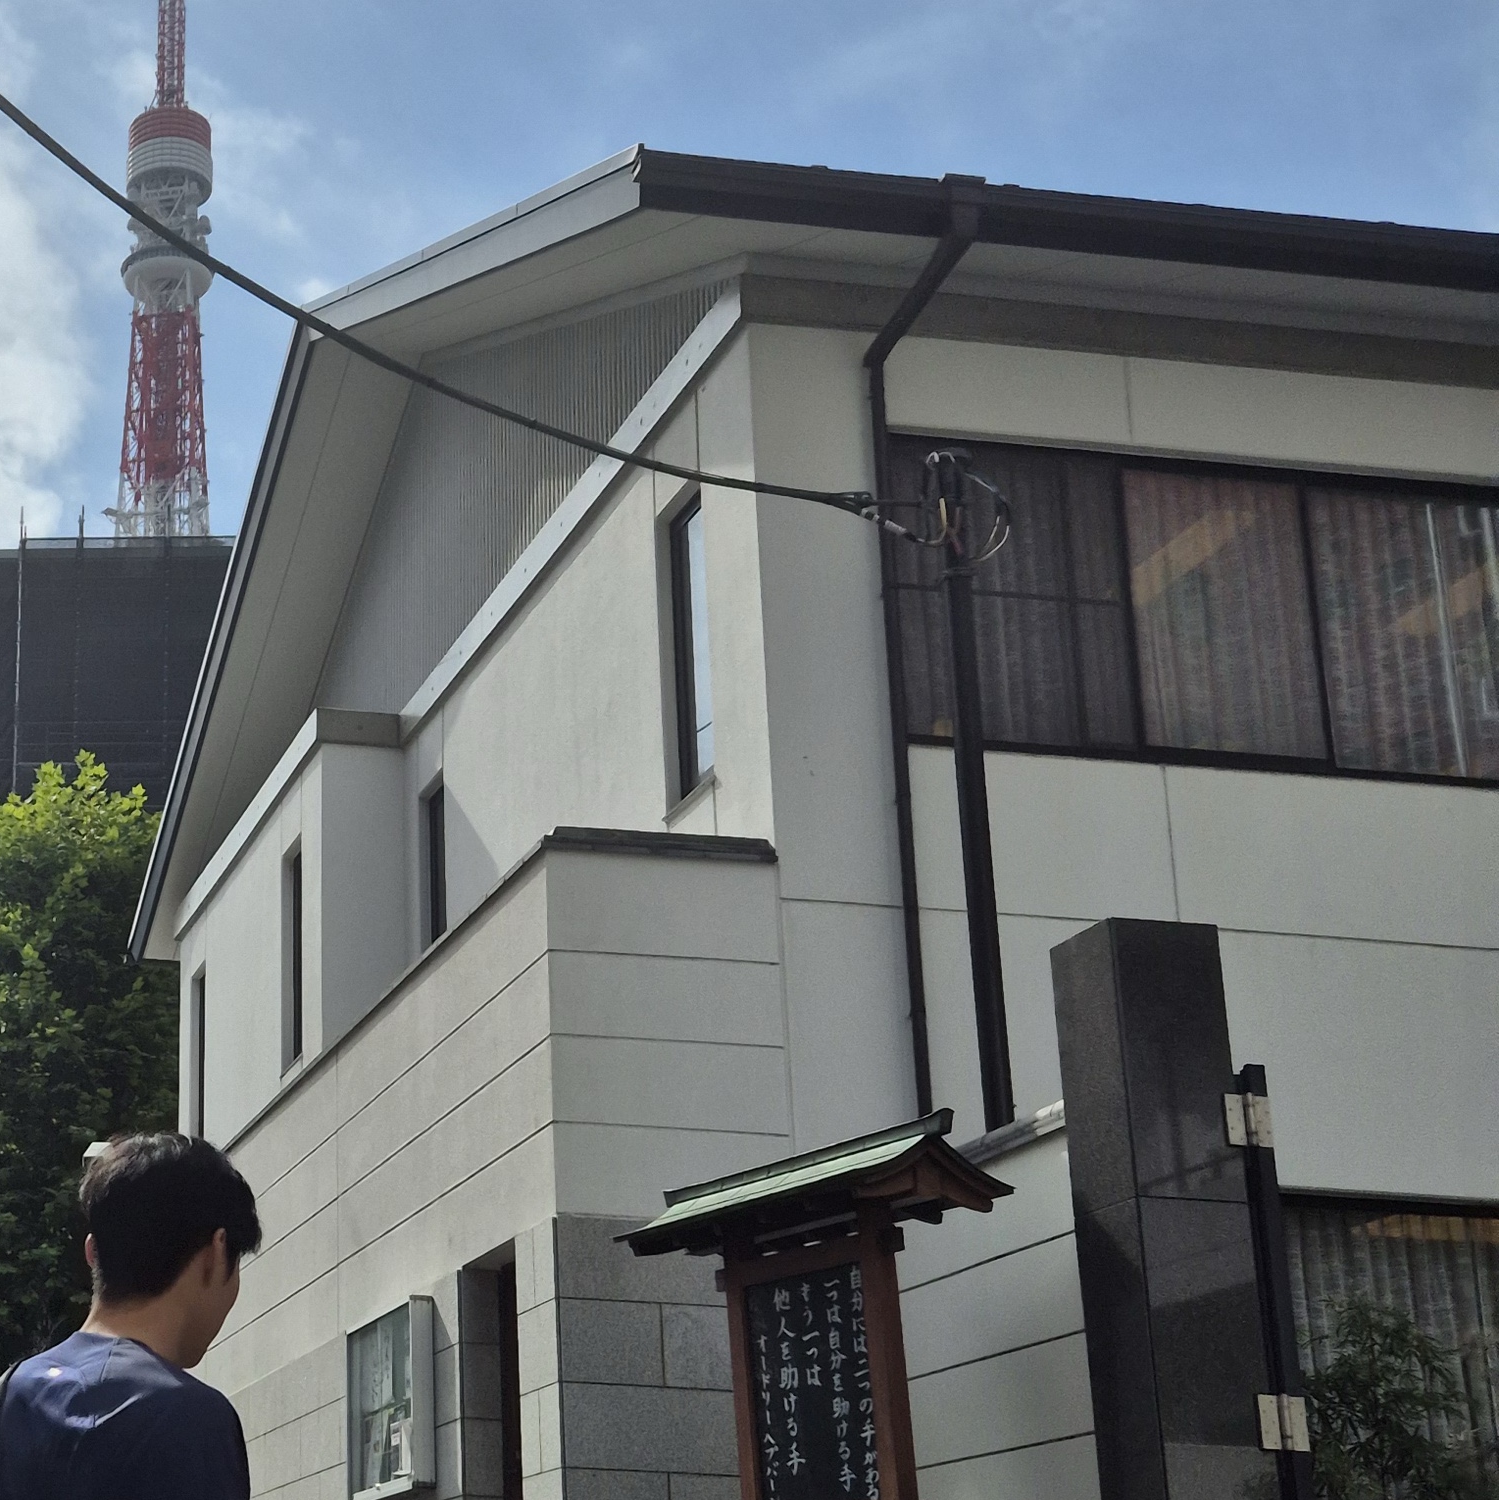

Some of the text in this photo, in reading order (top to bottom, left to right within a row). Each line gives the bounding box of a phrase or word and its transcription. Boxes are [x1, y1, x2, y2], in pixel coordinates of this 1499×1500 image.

[773, 1288, 806, 1476] 他人を助ける手
[800, 1282, 823, 1387] もう一つは
[823, 1279, 857, 1492] 一つは自分を助ける手
